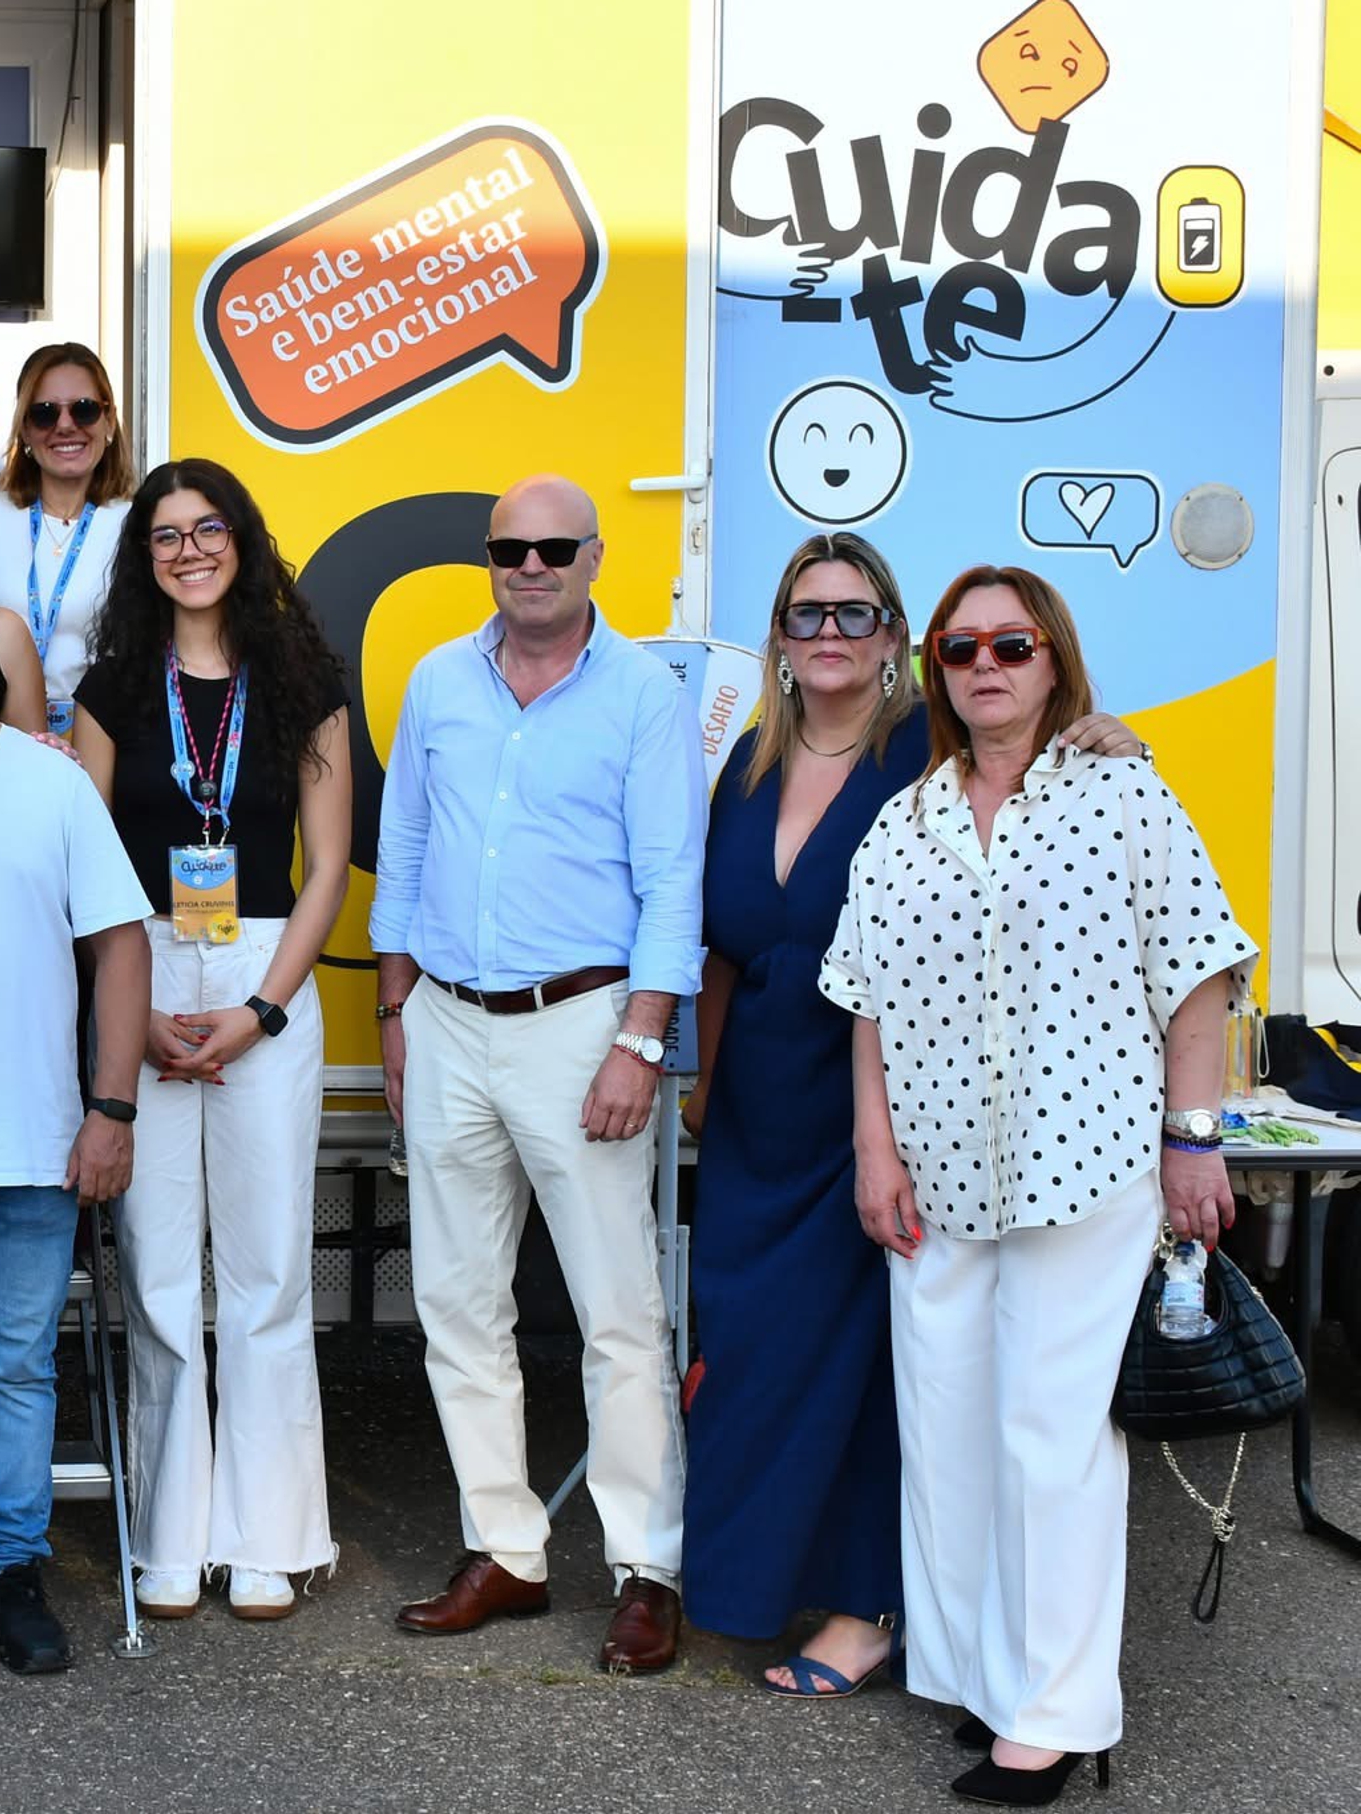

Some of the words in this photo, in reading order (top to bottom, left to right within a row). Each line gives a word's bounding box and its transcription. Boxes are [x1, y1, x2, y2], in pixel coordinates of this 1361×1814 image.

[224, 248, 364, 338] Saúde
[370, 147, 535, 263] mental
[718, 96, 1141, 299] Cuida
[271, 330, 300, 362] e
[295, 207, 530, 347] bem-estar
[303, 245, 538, 395] emocional
